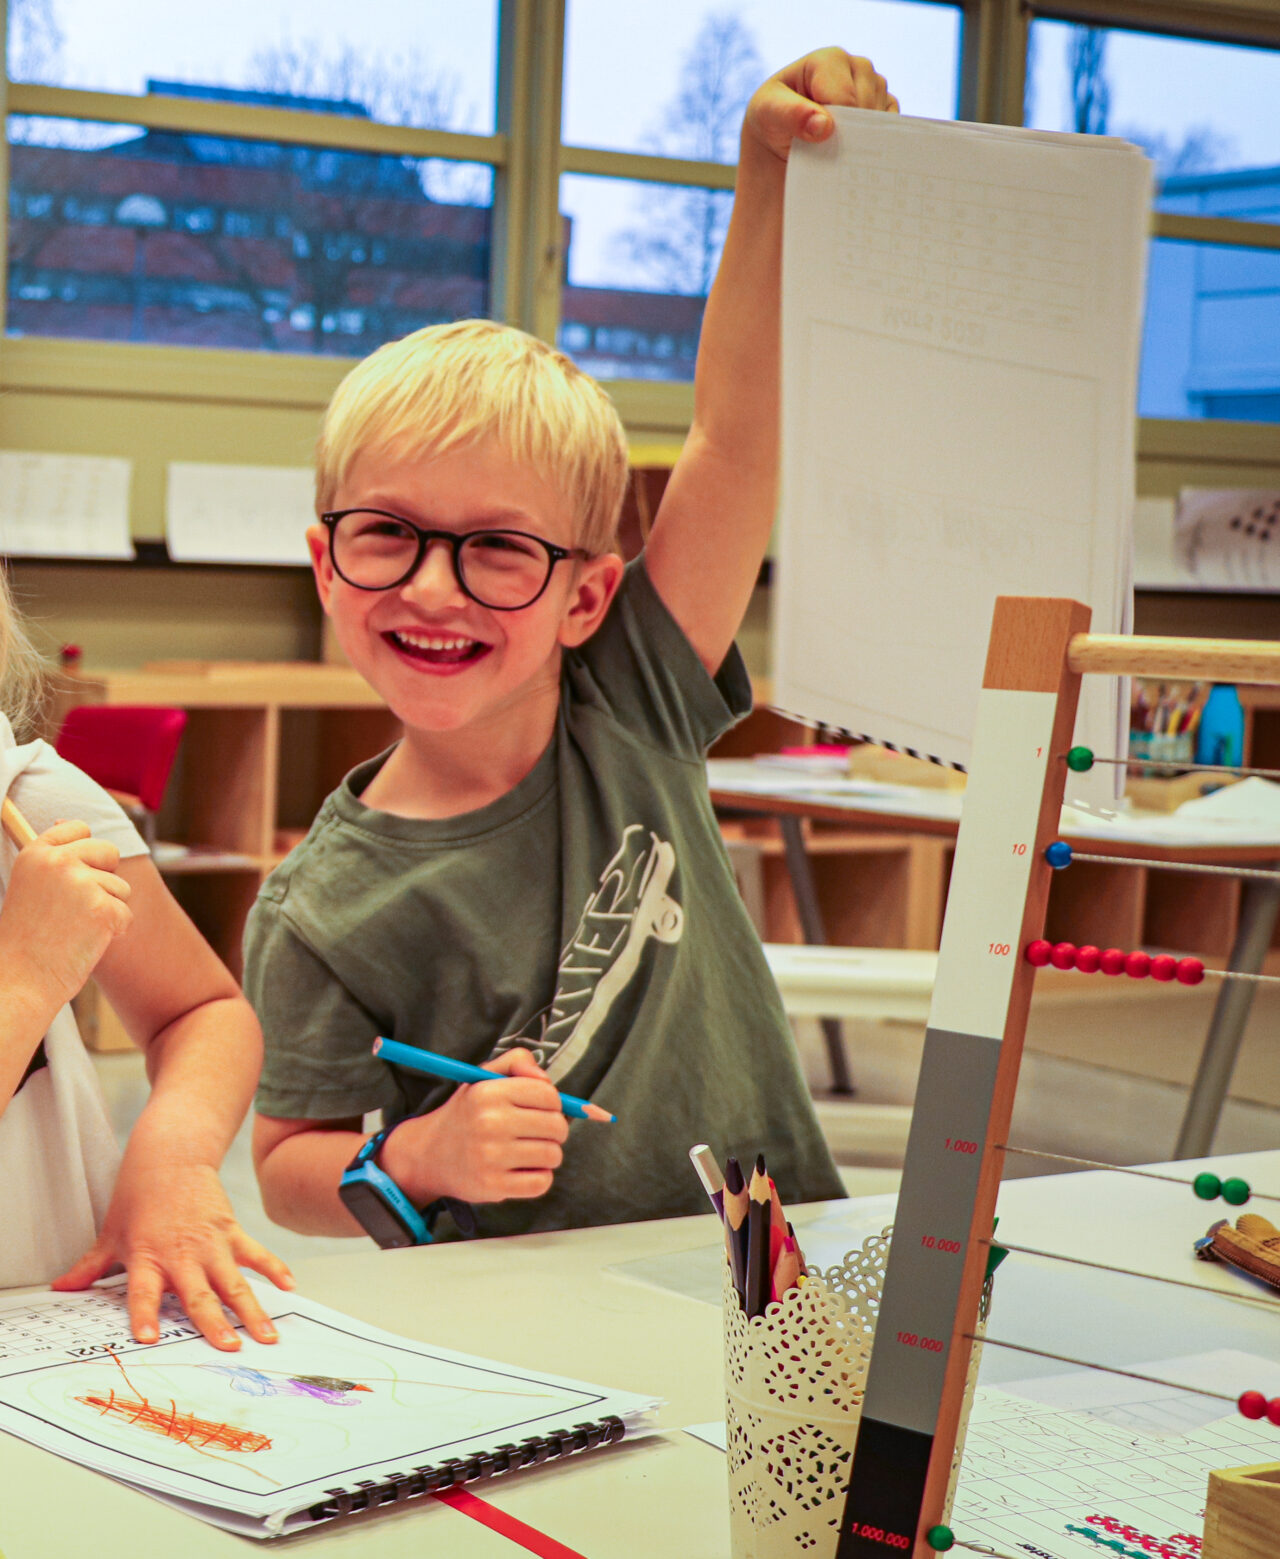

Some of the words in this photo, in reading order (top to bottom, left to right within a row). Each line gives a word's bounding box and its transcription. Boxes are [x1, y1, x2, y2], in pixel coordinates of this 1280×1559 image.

[1037, 747, 1042, 757] 1
[1012, 844, 1027, 856] 10
[988, 943, 1010, 957] 100
[944, 1138, 978, 1155] 1.000
[921, 1235, 961, 1254] 10.000
[65, 1342, 125, 1357] 2021
[897, 1331, 944, 1353] 100.000
[851, 1521, 911, 1550] 1.000.000
